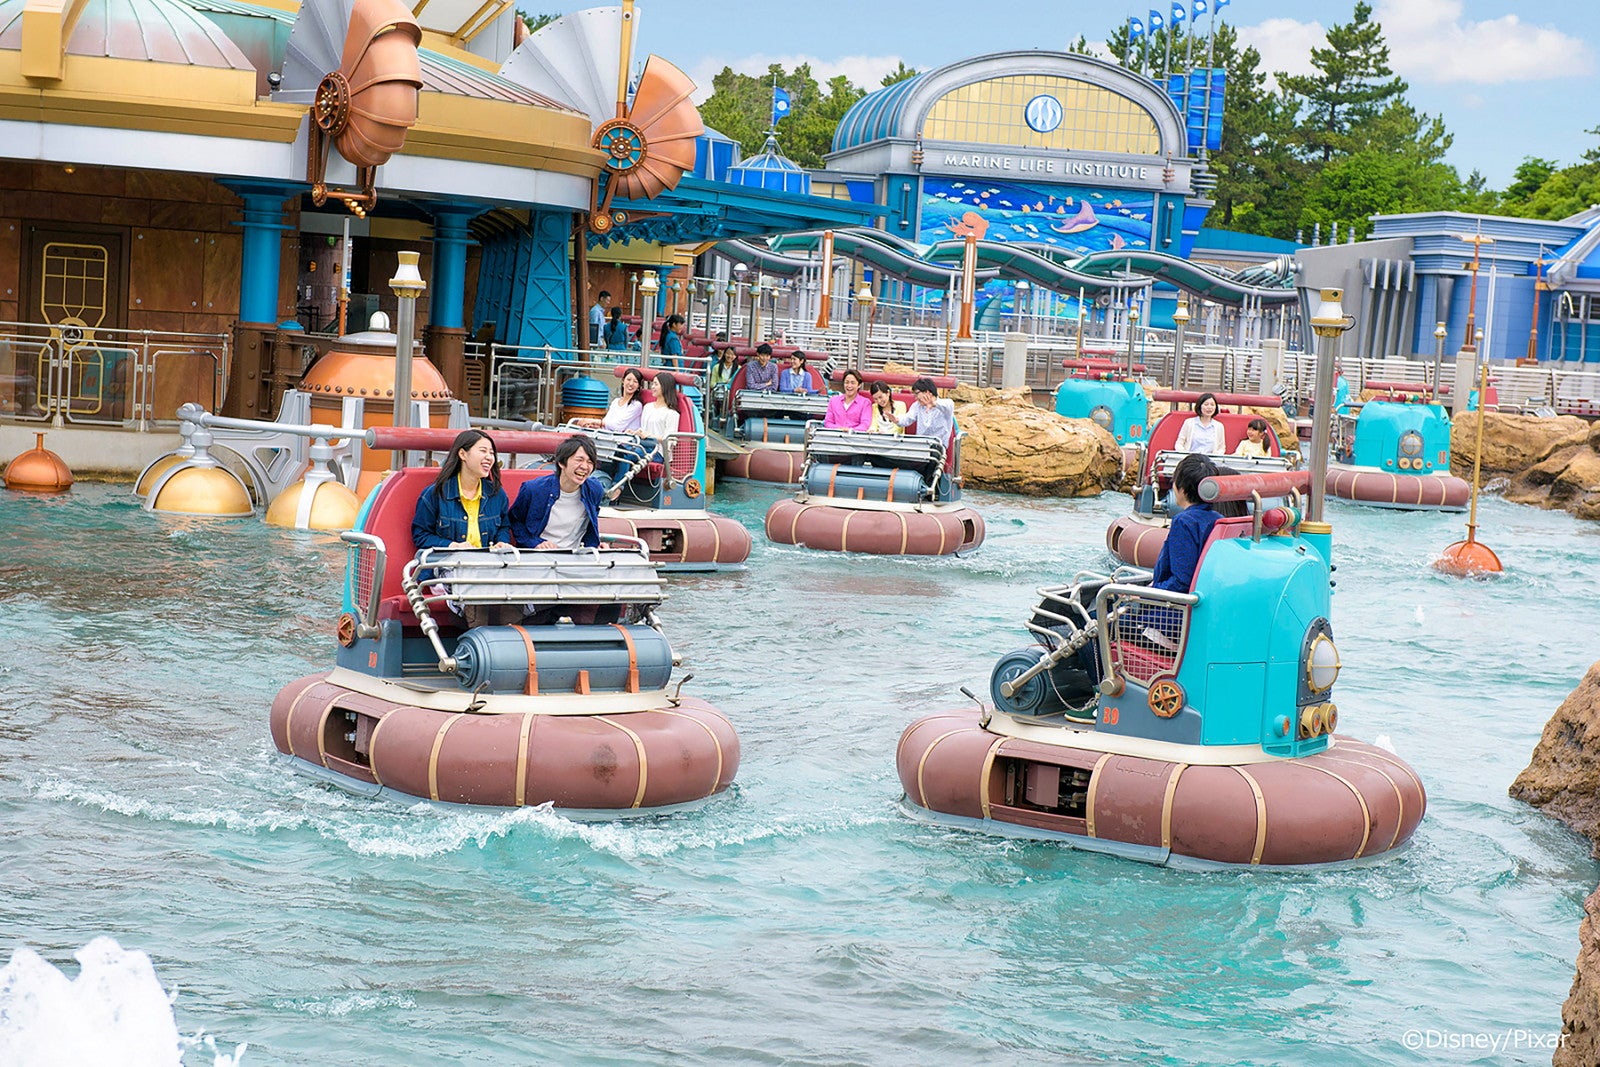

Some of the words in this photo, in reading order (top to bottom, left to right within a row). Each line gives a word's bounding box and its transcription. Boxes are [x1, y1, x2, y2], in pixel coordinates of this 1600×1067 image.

[944, 154, 1011, 170] MARINE
[1019, 158, 1054, 173] LIFE
[1065, 161, 1147, 179] INSTITUTE
[1103, 706, 1119, 725] 39
